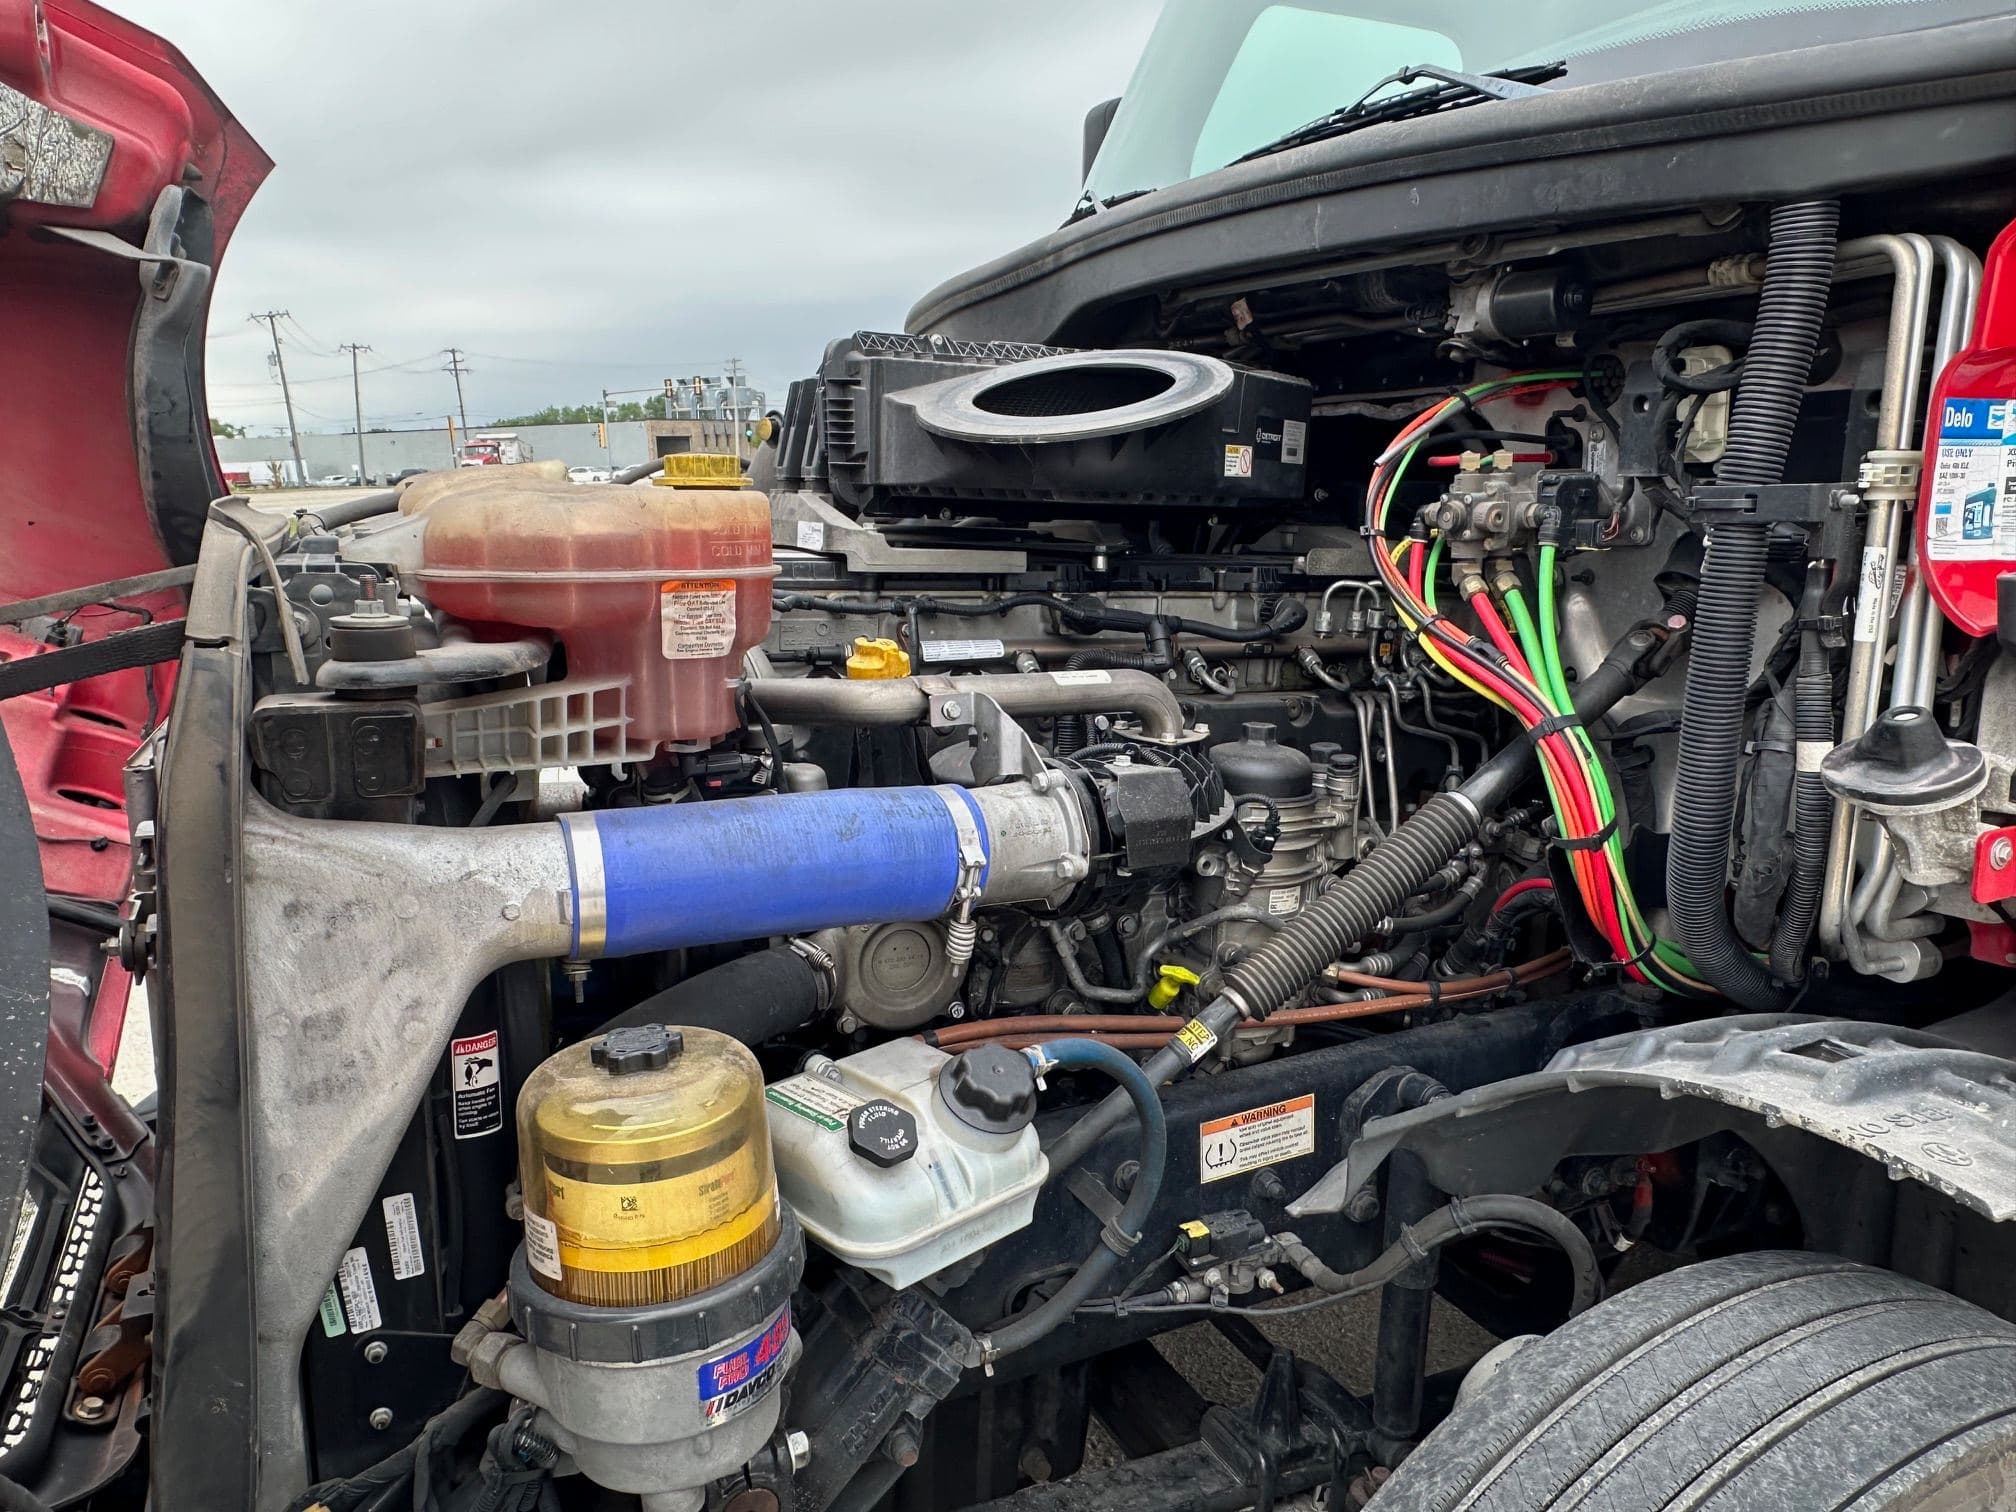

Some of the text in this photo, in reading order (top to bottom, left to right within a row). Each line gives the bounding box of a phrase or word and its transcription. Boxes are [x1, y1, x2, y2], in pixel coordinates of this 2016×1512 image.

[1944, 407, 1973, 428] Delo
[1955, 448, 1974, 458] ONLY
[1190, 1022, 1210, 1040] STEP
[1241, 1104, 1287, 1124] WARNING
[723, 1362, 776, 1409] DAVCO
